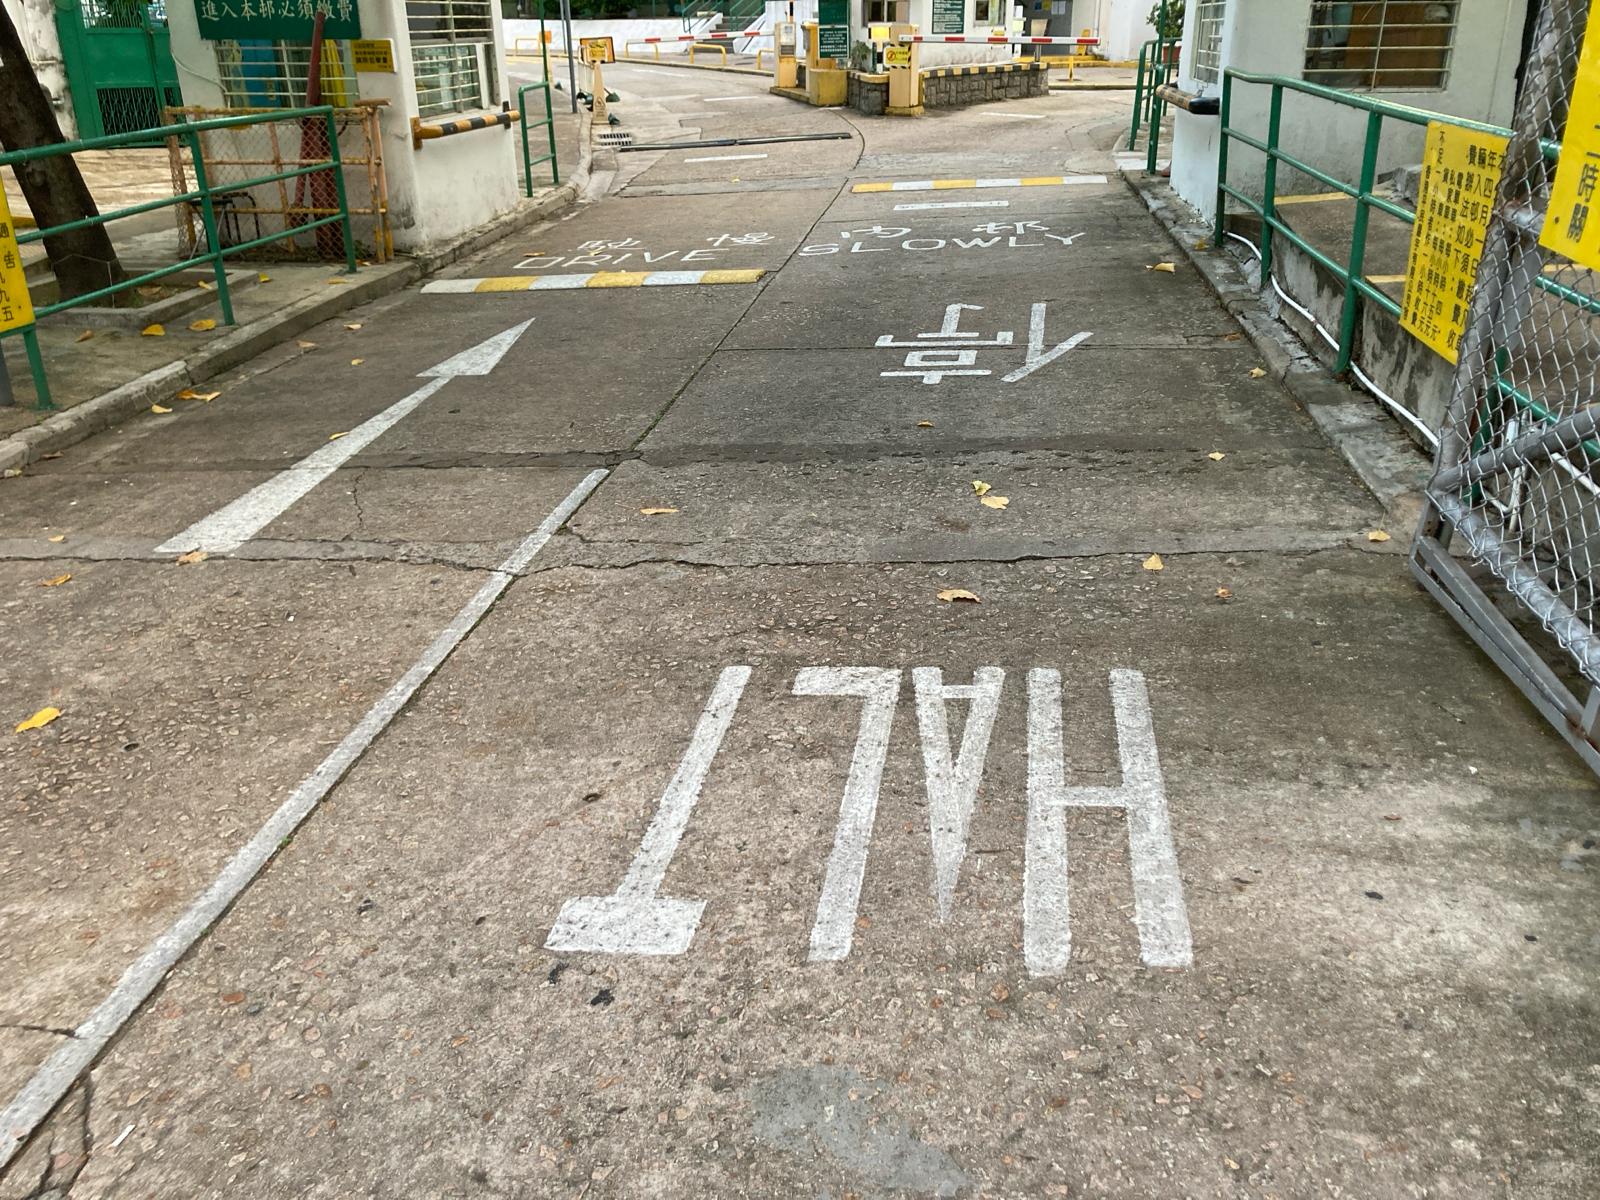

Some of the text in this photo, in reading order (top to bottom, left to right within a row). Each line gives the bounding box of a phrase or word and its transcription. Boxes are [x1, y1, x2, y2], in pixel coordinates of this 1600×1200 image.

[513, 232, 1086, 269] DRIVE SLOWLY
[874, 302, 1095, 385] 停
[544, 665, 1194, 978] HALT
